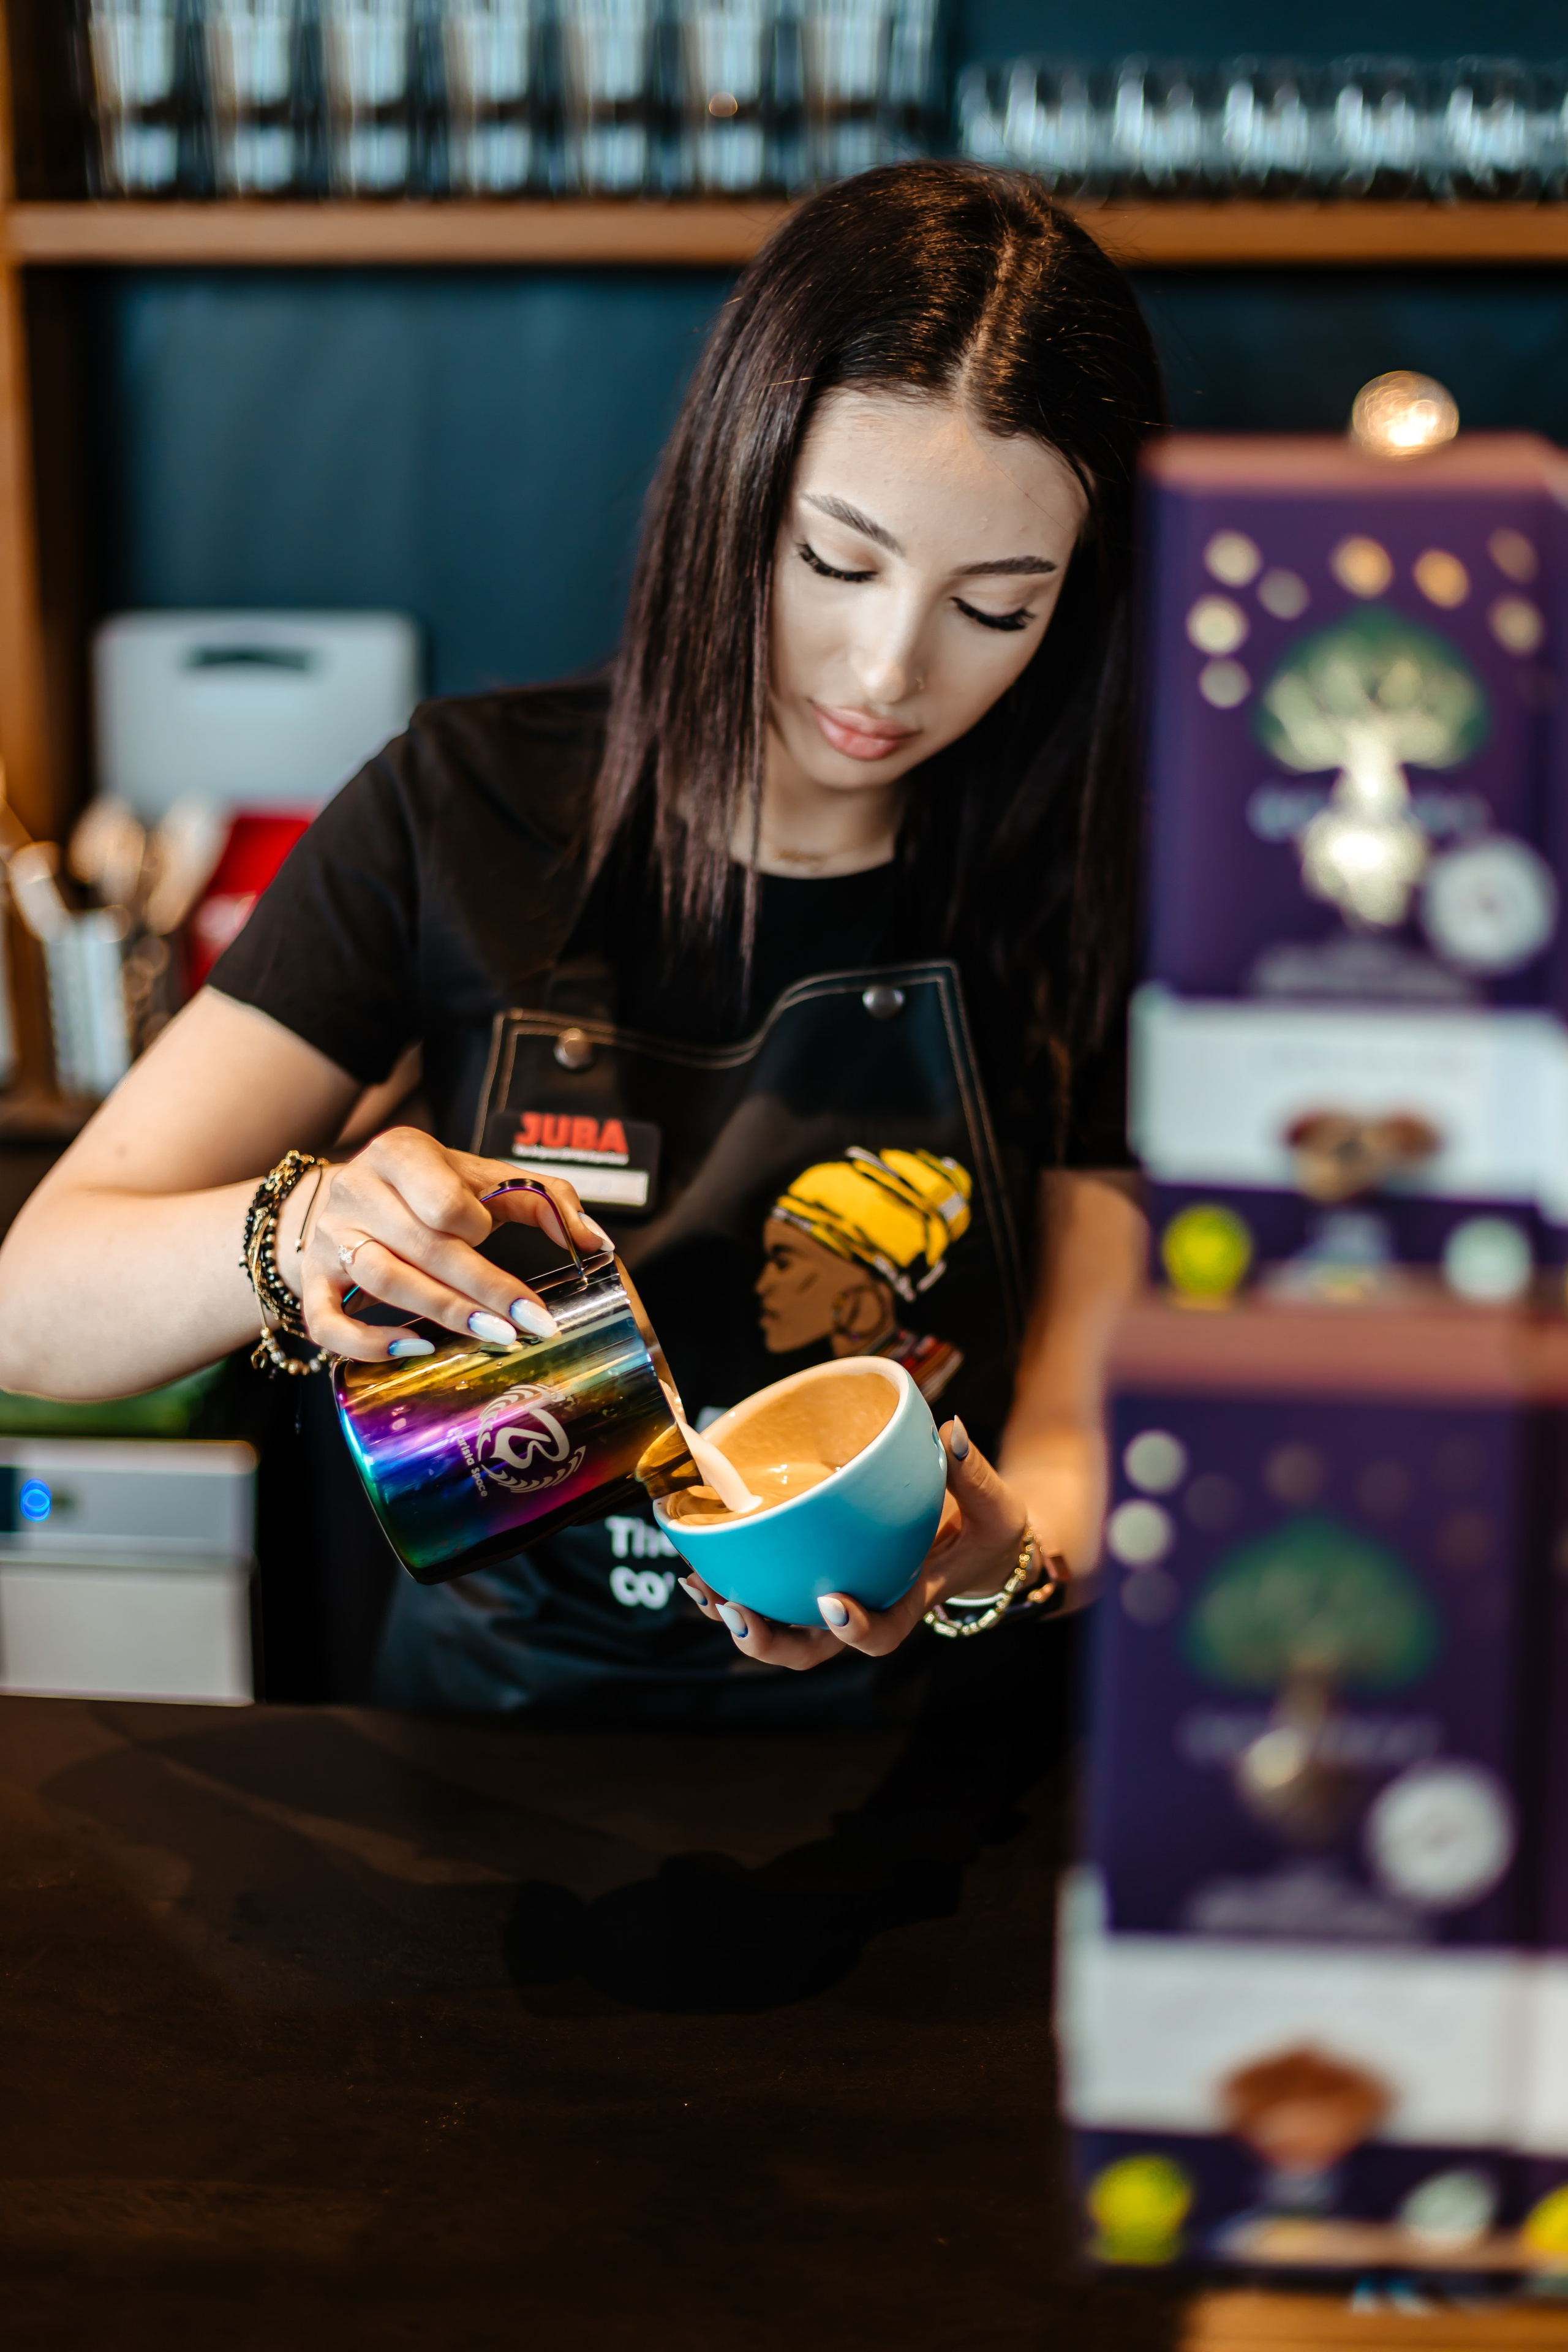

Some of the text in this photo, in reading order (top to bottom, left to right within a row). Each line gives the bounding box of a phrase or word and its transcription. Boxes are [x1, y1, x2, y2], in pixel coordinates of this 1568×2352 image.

[514, 1111, 629, 1155] JUBA
[454, 1428, 488, 1497] Barista Space
